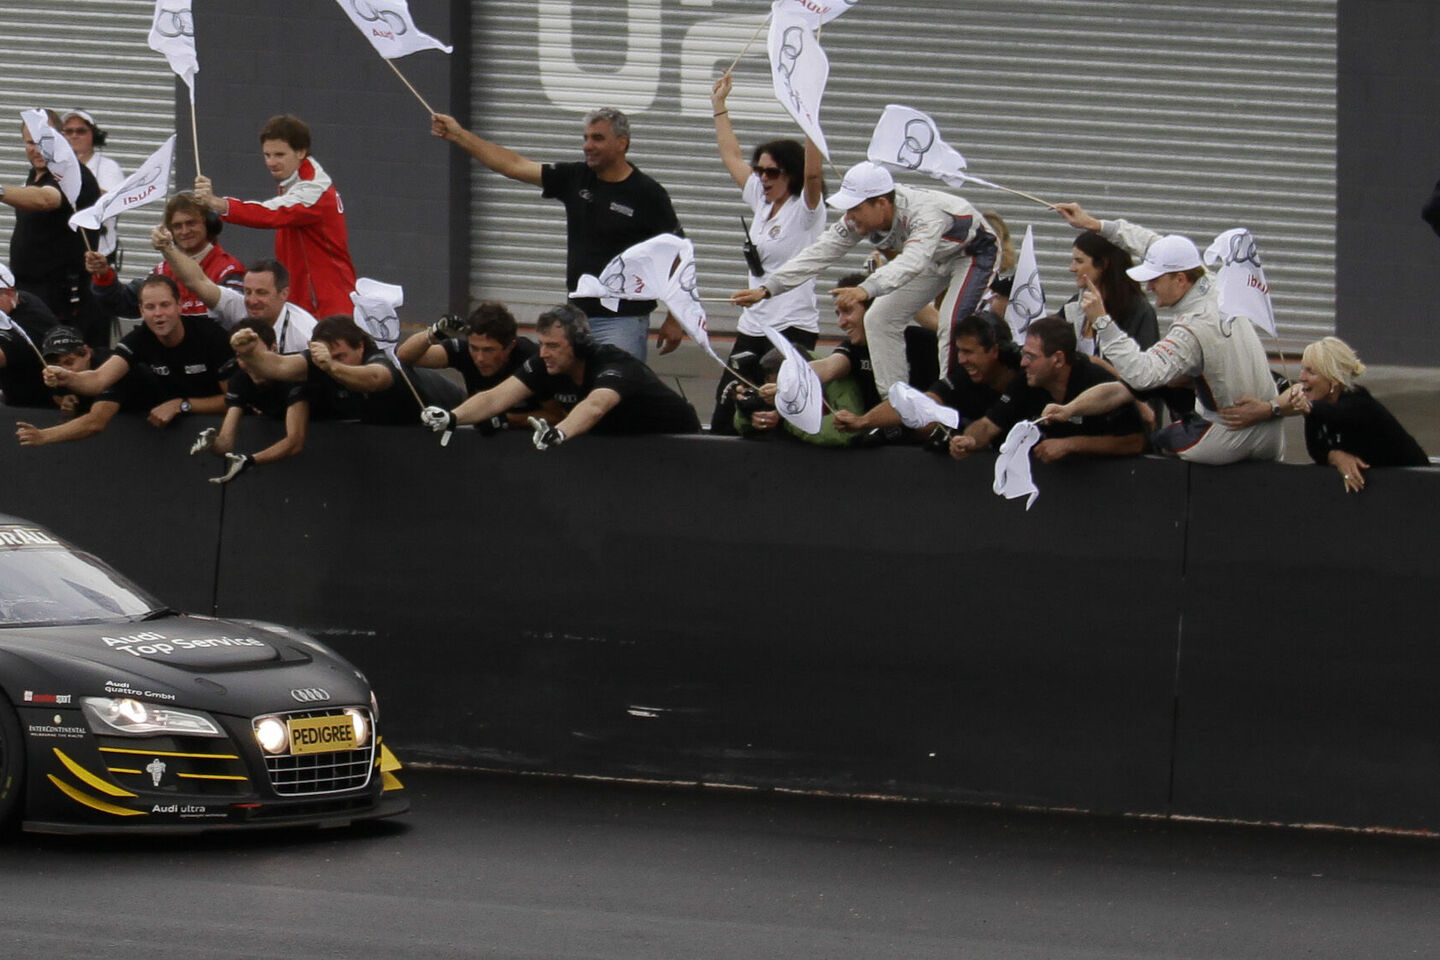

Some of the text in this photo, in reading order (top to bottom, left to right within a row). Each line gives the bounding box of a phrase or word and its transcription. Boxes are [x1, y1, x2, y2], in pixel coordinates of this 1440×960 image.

[101, 631, 167, 647] Audi
[116, 637, 265, 656] Top Service
[105, 680, 130, 688] Audi
[105, 686, 176, 701] quattro GmbH
[293, 725, 352, 745] PEDIGREE
[152, 804, 206, 813] Audi ultra
